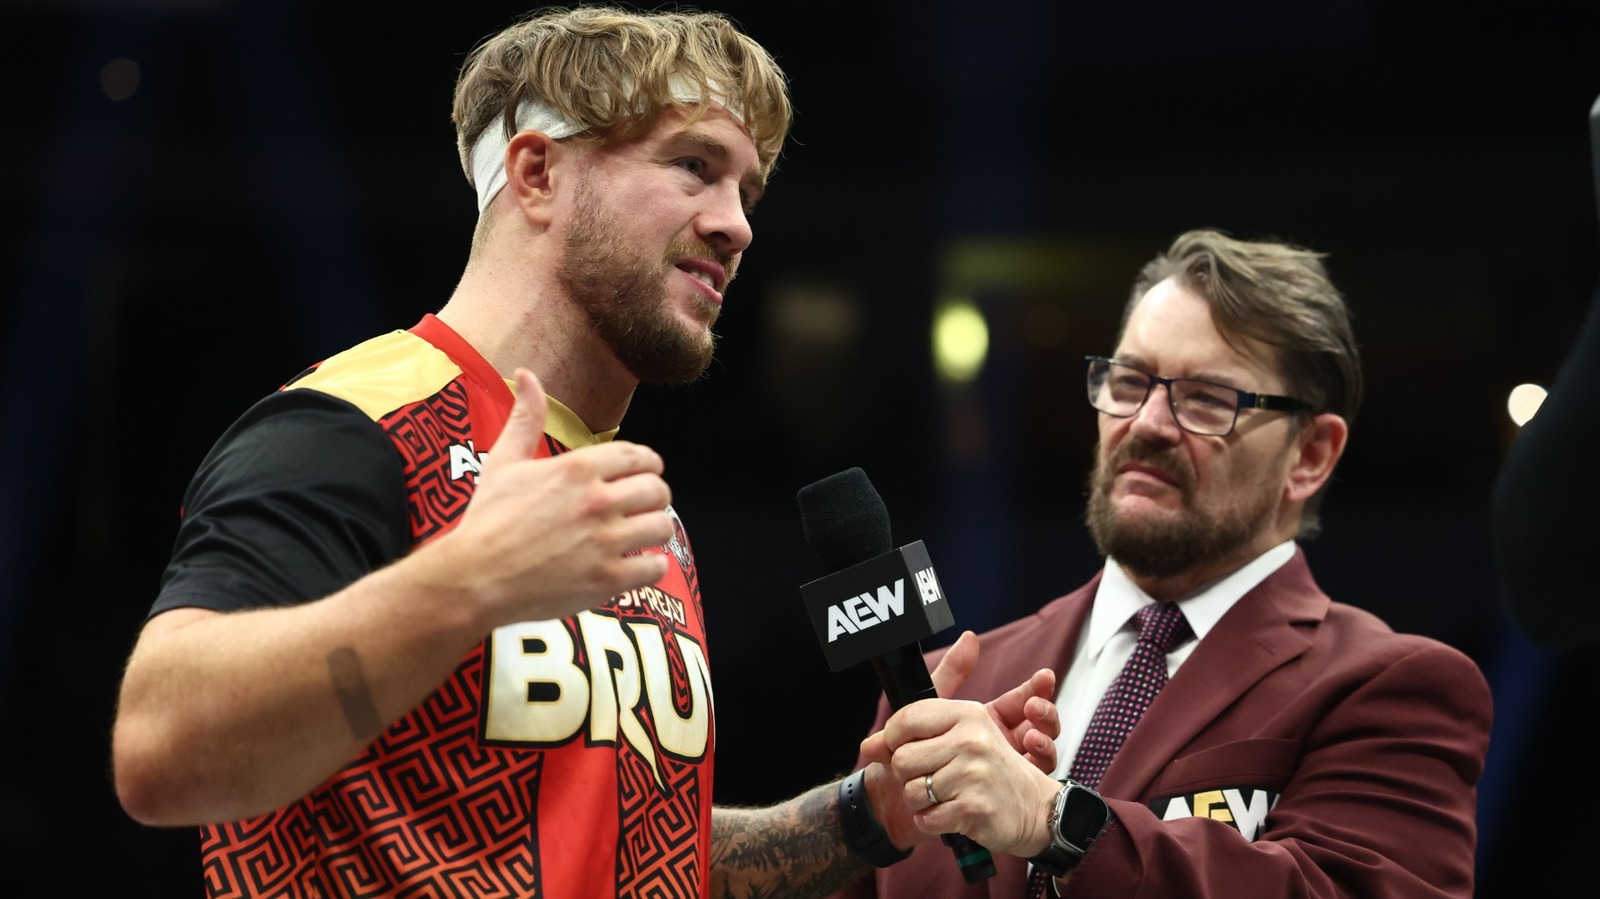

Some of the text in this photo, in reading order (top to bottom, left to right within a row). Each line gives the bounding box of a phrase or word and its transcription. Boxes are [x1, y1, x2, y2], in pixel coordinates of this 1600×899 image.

[611, 586, 687, 626] SPREAY
[828, 578, 904, 643] AEW
[915, 567, 941, 606] AEW
[485, 609, 715, 793] BRU
